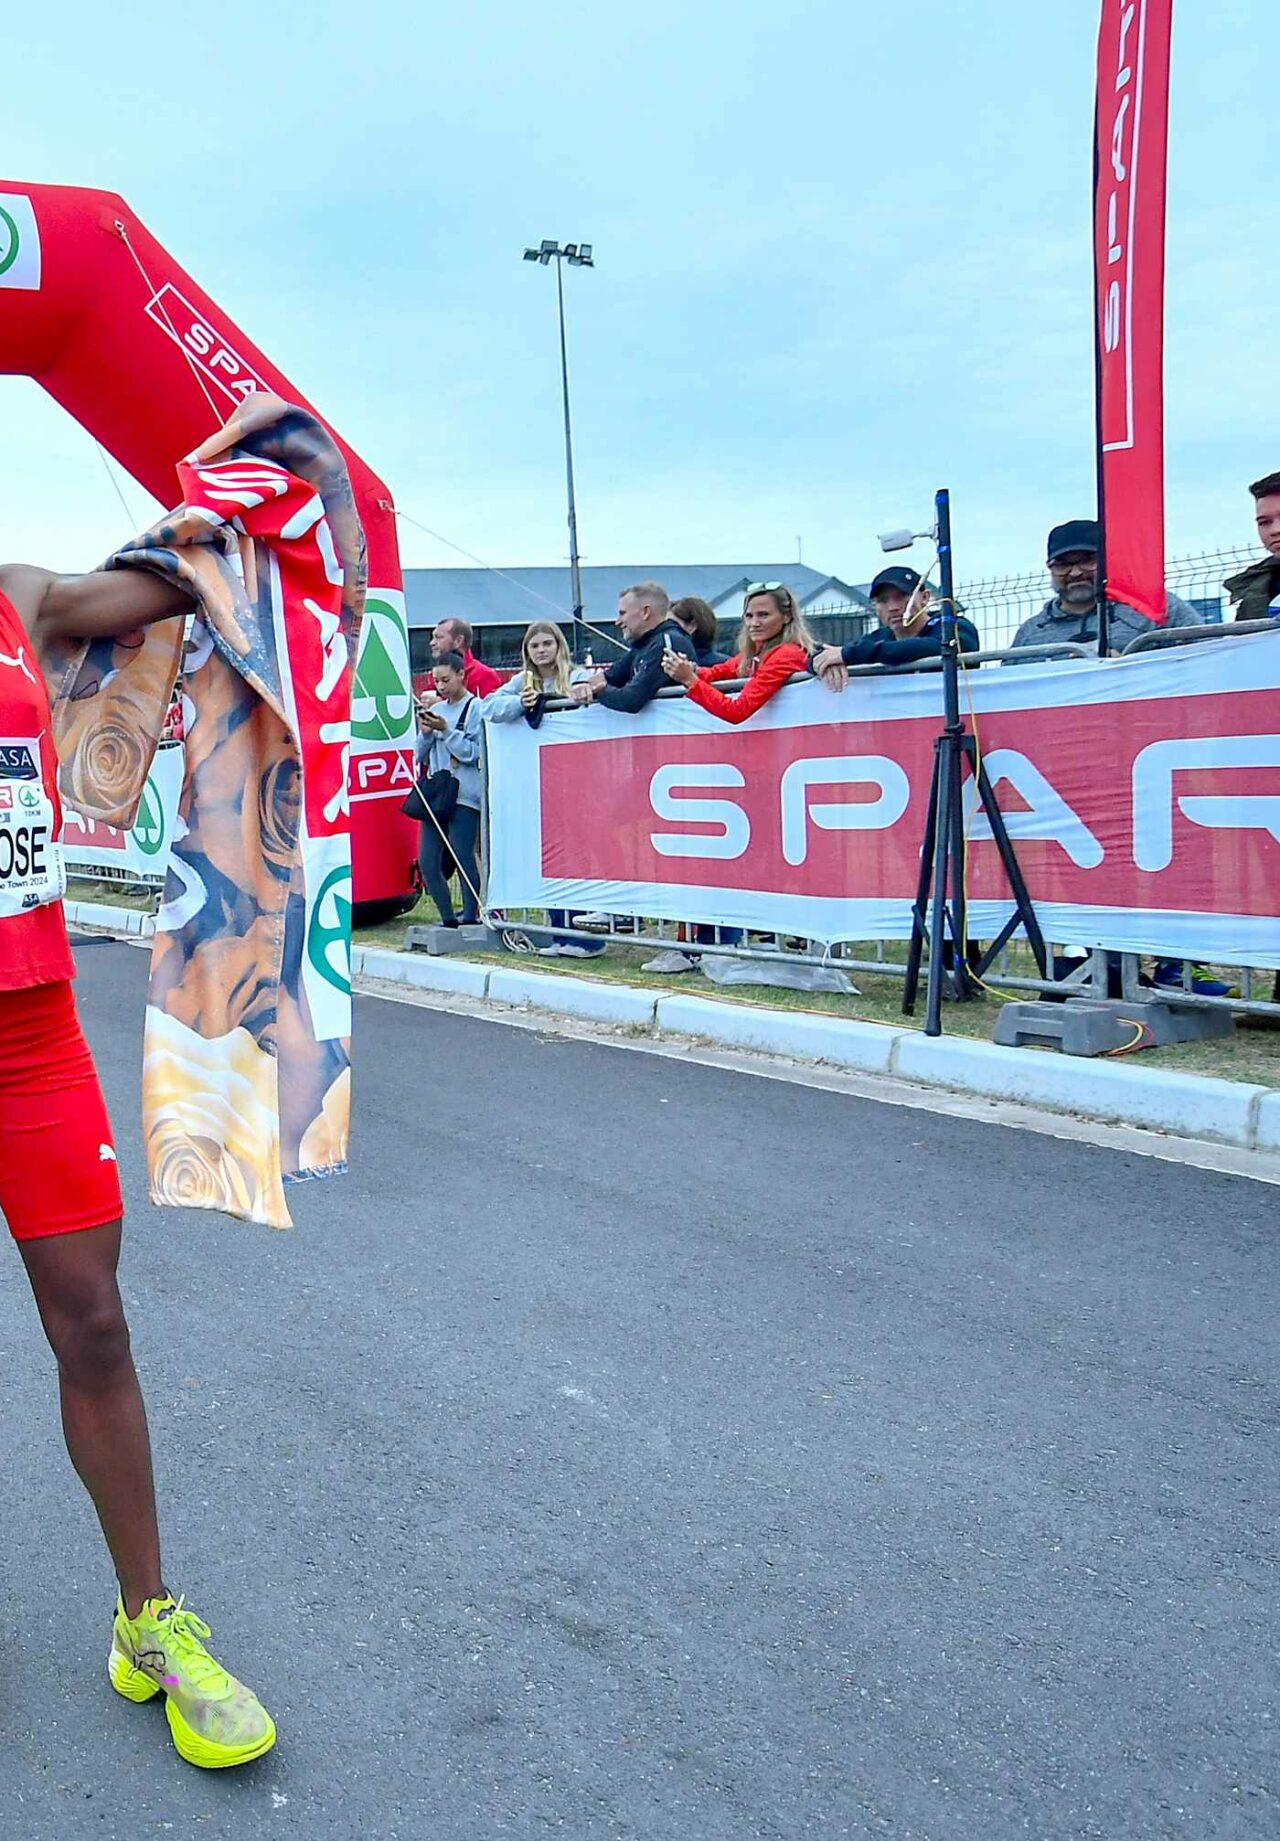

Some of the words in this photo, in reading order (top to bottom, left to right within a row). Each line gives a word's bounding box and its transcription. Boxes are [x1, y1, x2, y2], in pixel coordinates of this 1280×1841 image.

[183, 322, 258, 395] SPA
[8, 880, 28, 889] Town
[30, 876, 48, 886] 2024
